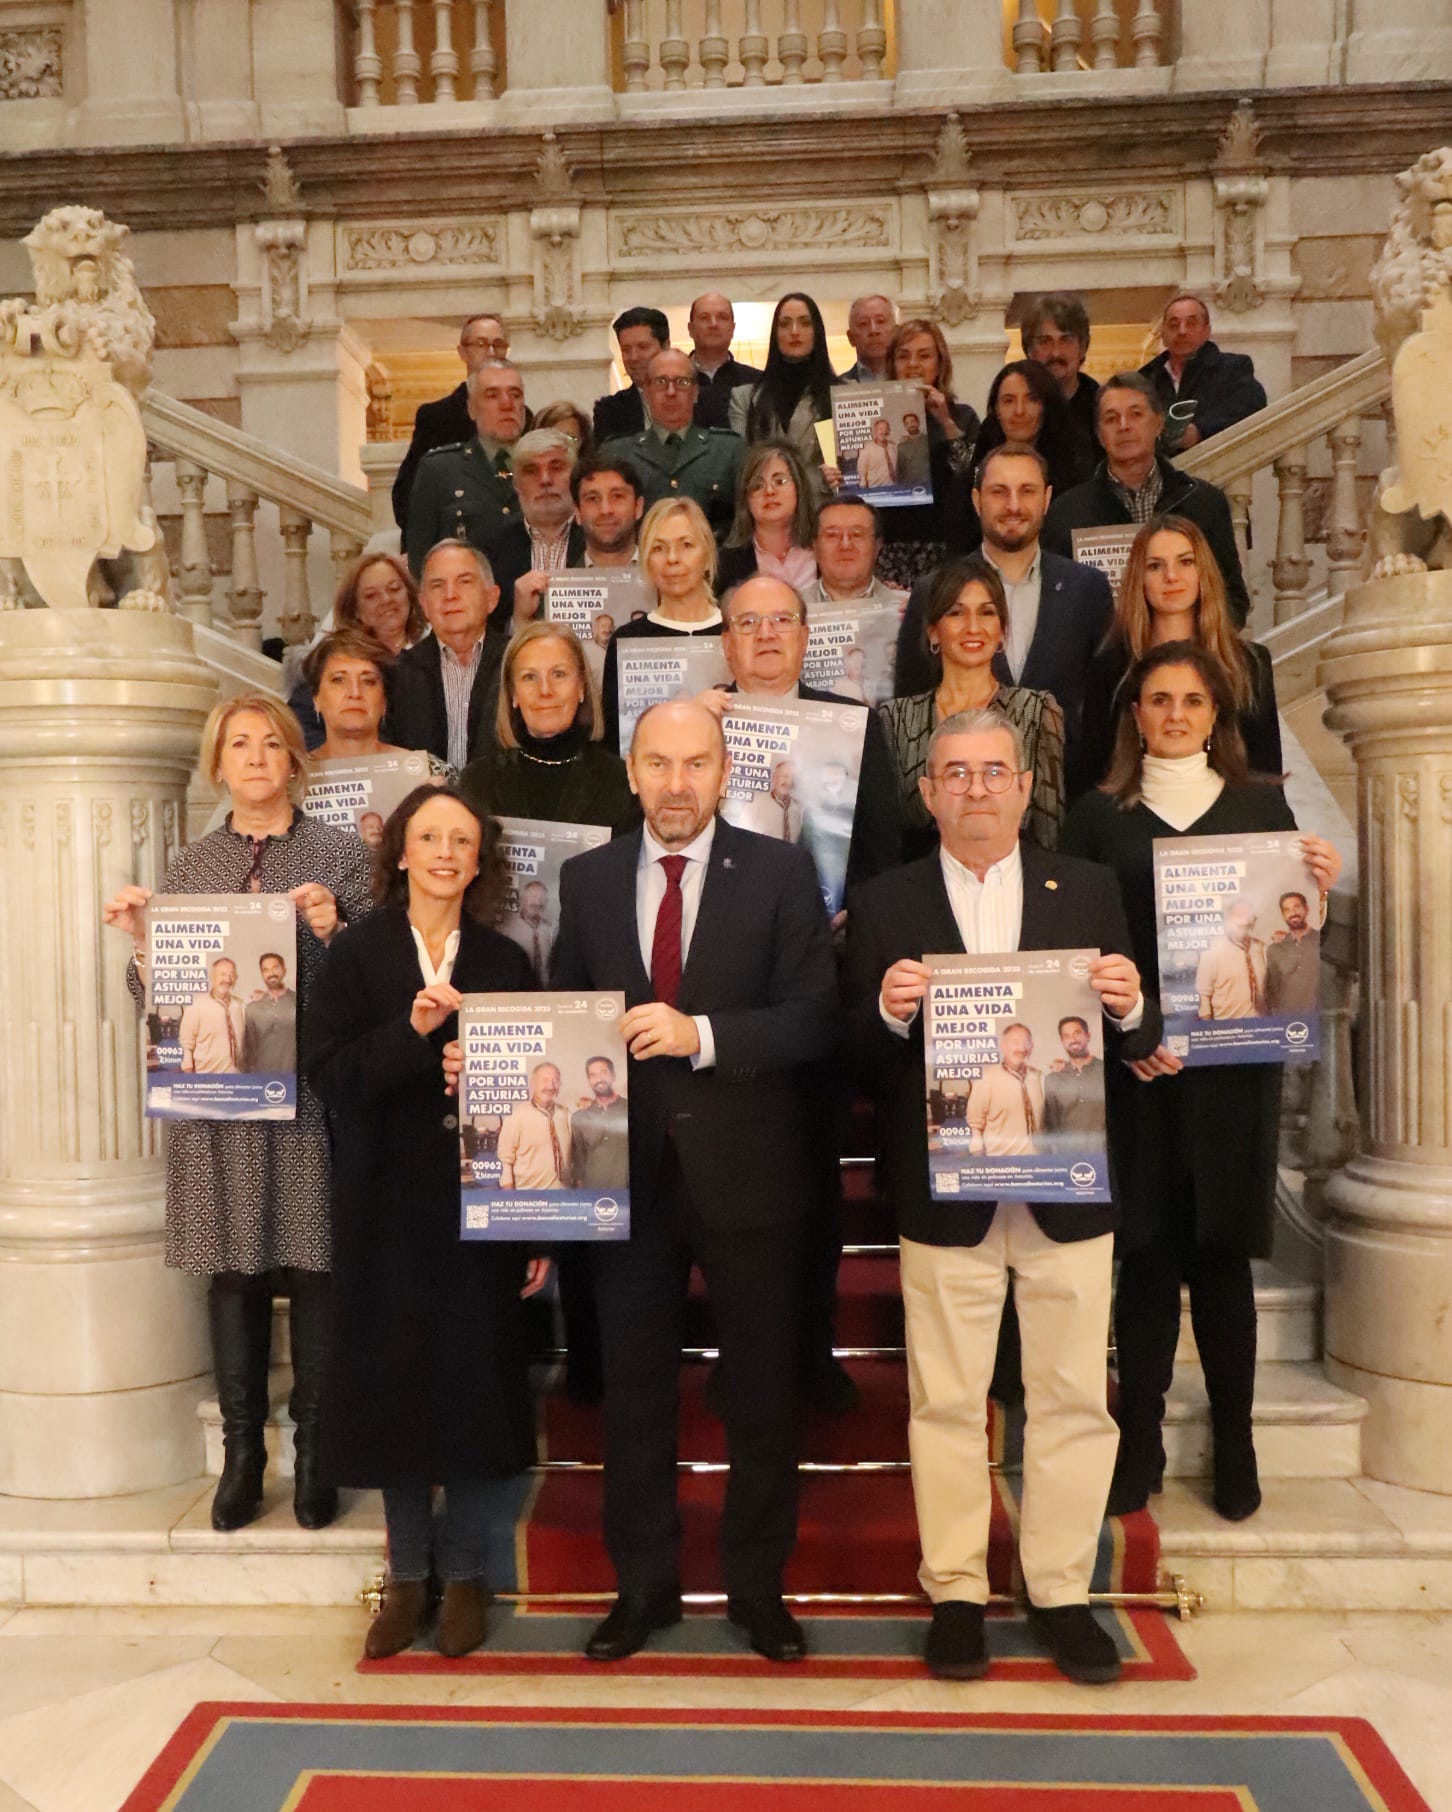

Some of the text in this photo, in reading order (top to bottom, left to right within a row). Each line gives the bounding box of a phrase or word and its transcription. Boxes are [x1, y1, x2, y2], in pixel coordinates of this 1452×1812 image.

[837, 400, 879, 410] ALIMENTA
[839, 420, 867, 428] MEJOR
[840, 435, 873, 444] ASTURIAS
[840, 443, 864, 451] MEJOR
[1080, 546, 1132, 557] ALIMENTA
[551, 589, 602, 597] ALIMENTA
[551, 600, 602, 609] UNA VIDA
[552, 612, 586, 620] MEJOR
[809, 623, 853, 634] LIMENTA
[809, 635, 853, 646] NA VIDA
[625, 661, 681, 670] ALIMENTA
[823, 660, 844, 668] UNA
[625, 674, 681, 683] UNA VIDA
[804, 669, 845, 679] ASTURIAS
[805, 680, 834, 688] MEJOR
[625, 687, 664, 696] MEJOR
[724, 719, 791, 737] ALIMENTA
[724, 735, 788, 752] UNA VIDA
[744, 768, 769, 778] UNA
[726, 778, 769, 790] STURIAS
[724, 791, 753, 801] EJOR
[305, 797, 367, 811] UNA VIDA
[1164, 865, 1237, 878] ALIMENTA
[1165, 880, 1237, 894] UNA VIDA
[248, 902, 262, 910] 24
[1166, 898, 1214, 910] MEJOR
[1166, 913, 1223, 925] POR UNA
[154, 924, 222, 934] ALIMENTA
[1167, 926, 1225, 938] ASTURIAS
[155, 940, 222, 949] UNA VIDA
[1167, 940, 1208, 950] MEJOR
[155, 955, 200, 964] MEJOR
[1045, 960, 1061, 968] 24
[154, 970, 207, 979] POR UNA
[940, 967, 963, 975] GRAN
[964, 966, 1001, 974] RECOGIDA
[153, 982, 207, 991] ASTURIAS
[934, 985, 1014, 999] ALIMENTA
[154, 995, 192, 1004] MEJOR
[1171, 994, 1200, 1002] 00962
[574, 1000, 588, 1009] 24
[935, 1003, 1013, 1017] UNA VIDA
[468, 1024, 544, 1036] ALIMENTA
[935, 1022, 988, 1034] MEJOR
[469, 1042, 544, 1054] UNA VIDA
[935, 1038, 997, 1050] POR UNA
[156, 1047, 184, 1055] 00962
[935, 1053, 998, 1065] ASTURIAS
[469, 1060, 519, 1070] MEJOR
[936, 1068, 981, 1079] MEJOR
[468, 1075, 527, 1086] POR UNA
[468, 1090, 528, 1100] ASTURIAS
[469, 1104, 512, 1114] MEJOR
[939, 1127, 972, 1136] 00962
[472, 1161, 502, 1170] 00962
[985, 1166, 1021, 1174] DONACIÓN
